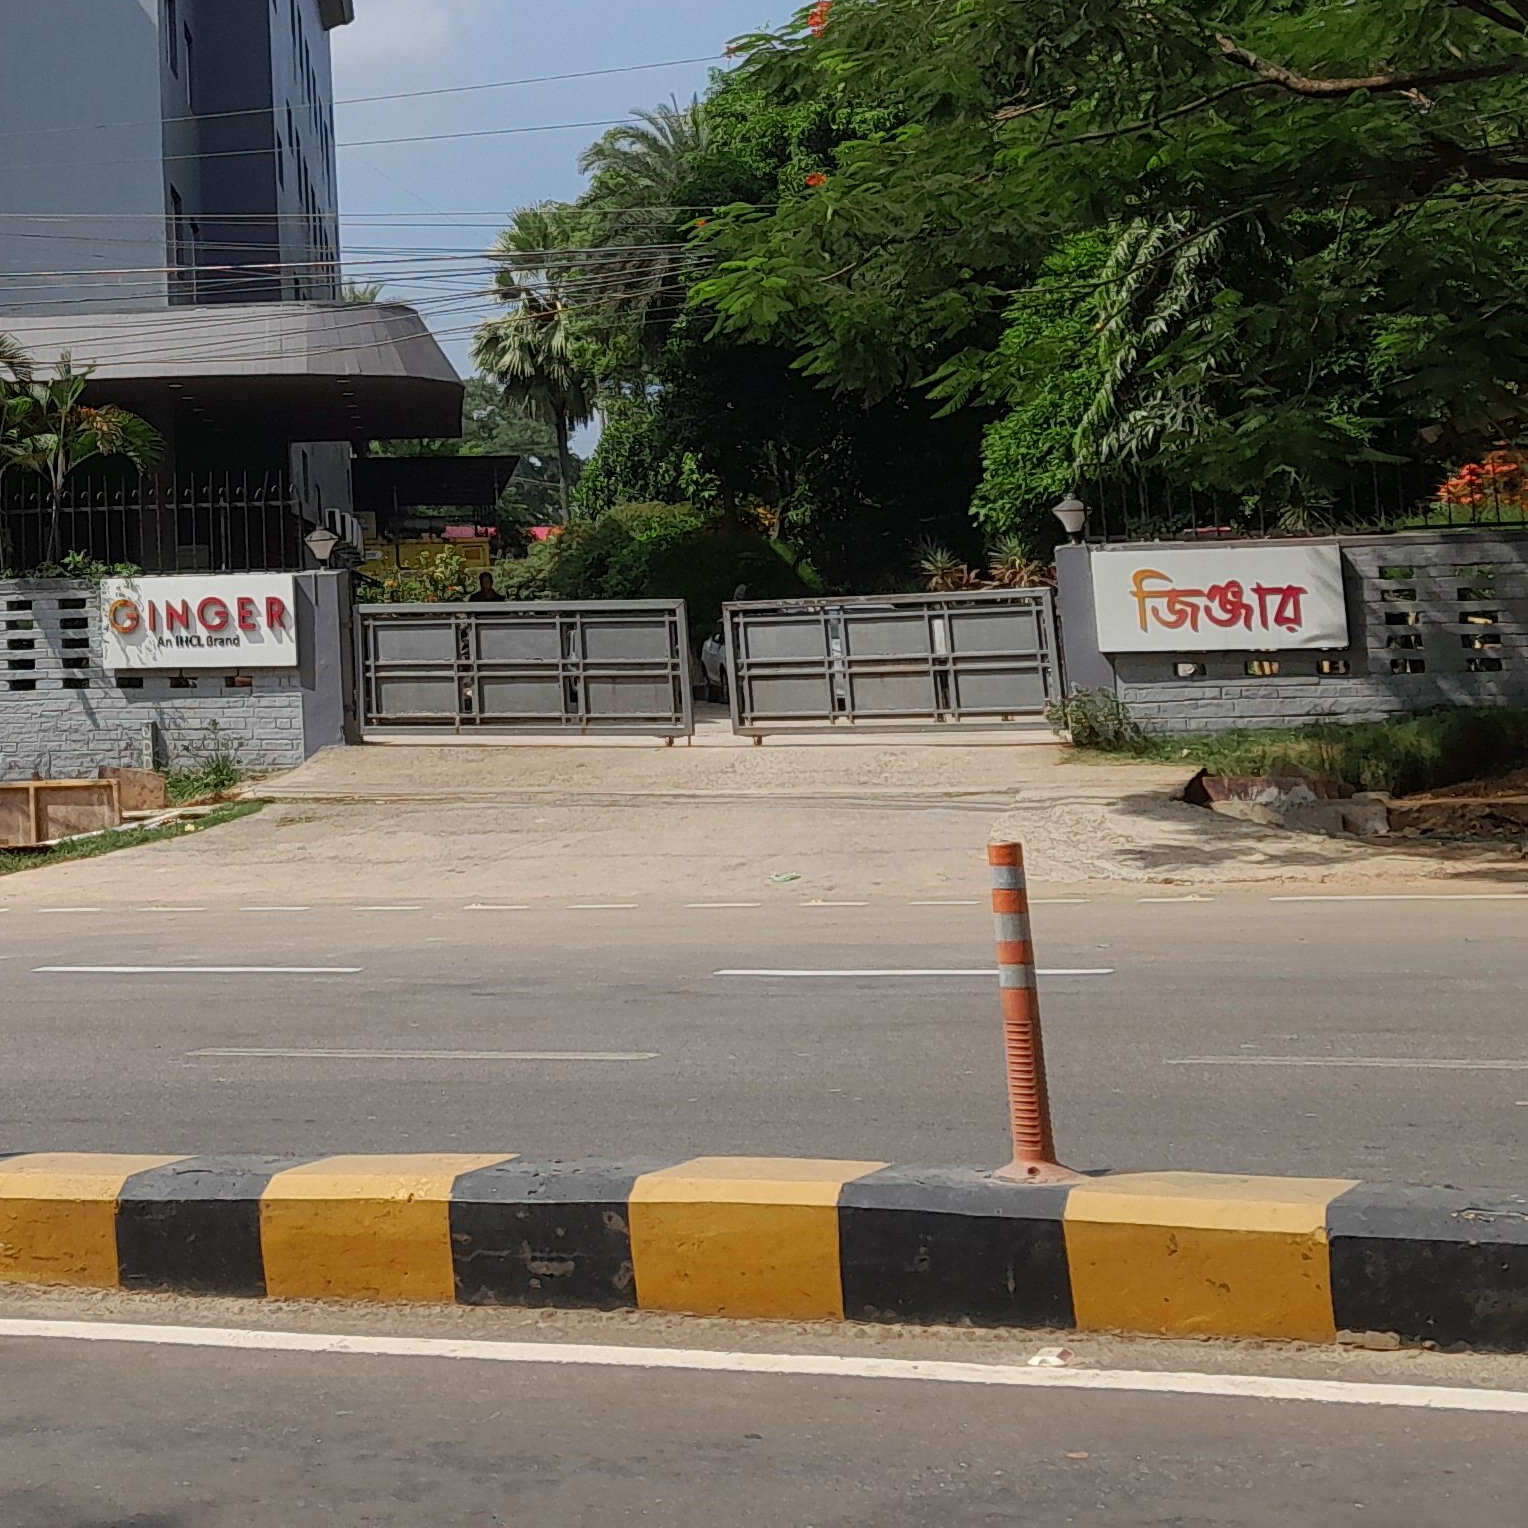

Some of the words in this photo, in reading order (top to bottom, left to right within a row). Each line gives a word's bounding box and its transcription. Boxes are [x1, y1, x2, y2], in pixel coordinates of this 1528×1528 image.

[108, 596, 287, 634] GINGER
[1129, 568, 1308, 633] জিঞ্জার
[157, 635, 173, 648] An
[175, 635, 204, 648] IHCL
[206, 634, 241, 648] Brand
